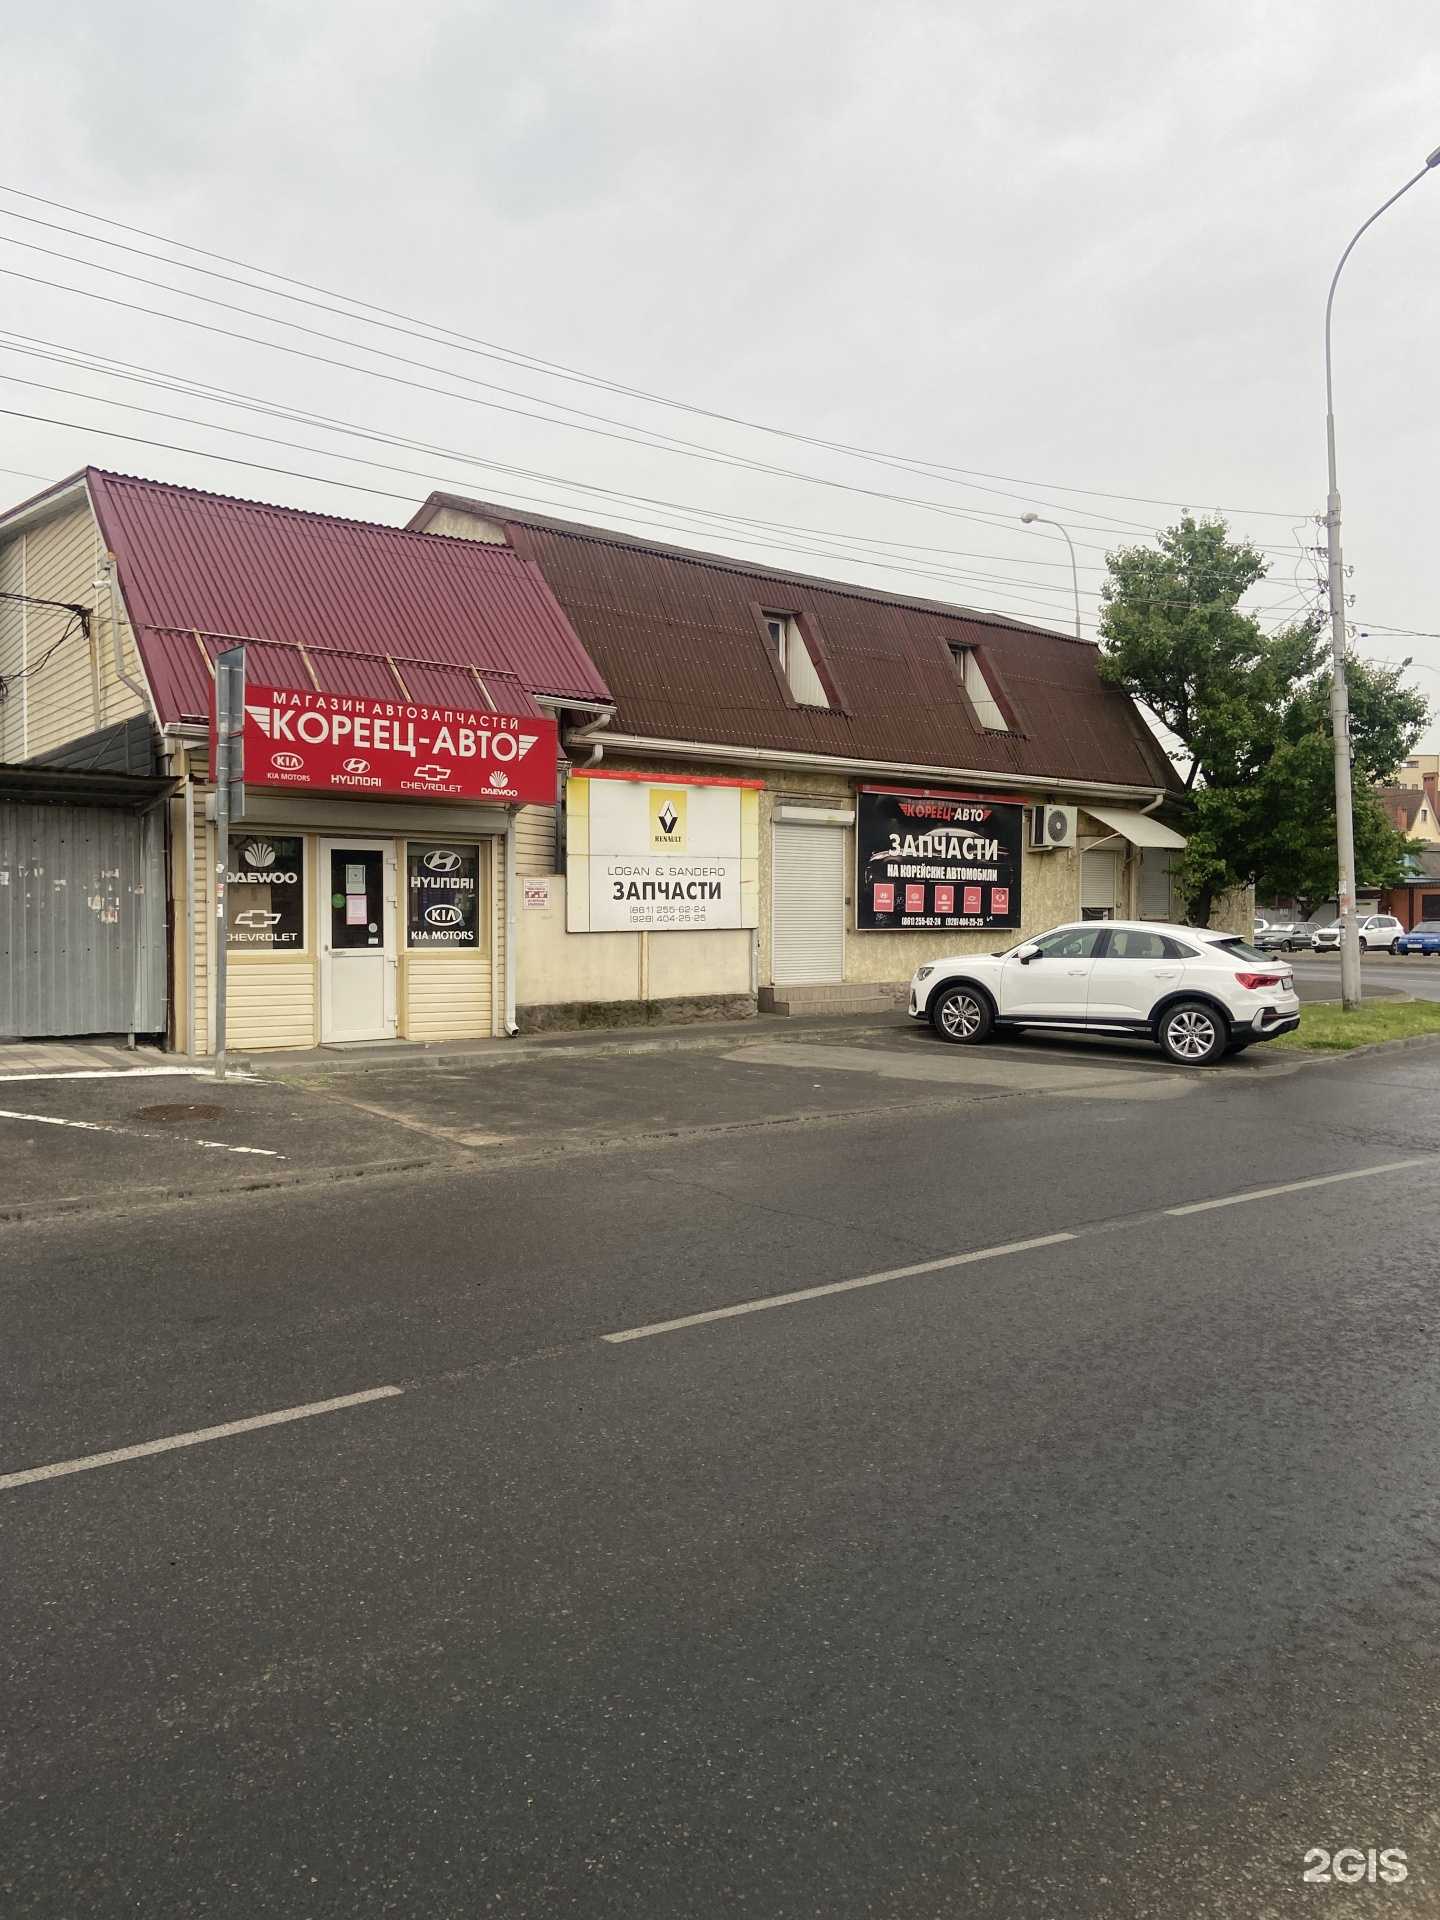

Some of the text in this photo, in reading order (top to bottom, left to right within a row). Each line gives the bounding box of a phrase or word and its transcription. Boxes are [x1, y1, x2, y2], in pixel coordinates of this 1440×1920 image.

[273, 691, 519, 730] МАГАЗИН АВТОЗАПЧАСТЕЙ
[273, 708, 518, 761] КОРЕЕЦ-АВТО
[276, 756, 299, 767] KIA
[280, 773, 310, 782] MOTORS
[331, 775, 382, 787] HYUNDAI
[400, 781, 463, 793] CHEVROLET
[480, 787, 518, 797] DAEWOO
[906, 803, 984, 822] КОРЕЕЦ-АВТО
[654, 835, 682, 843] RENAULT
[888, 833, 998, 860] ЗАПЧАСТИ
[607, 866, 726, 877] LOGAN & SANDERO
[887, 863, 998, 881] НА КОРЕЙСКИЕ АВТОМОБИЛИ
[226, 872, 298, 884] DAEWOO
[410, 876, 474, 889] HYUNDAI
[613, 881, 721, 900] ЗАПЧАСТИ
[431, 909, 457, 921] KIA
[411, 931, 474, 940] KIA MOTORS
